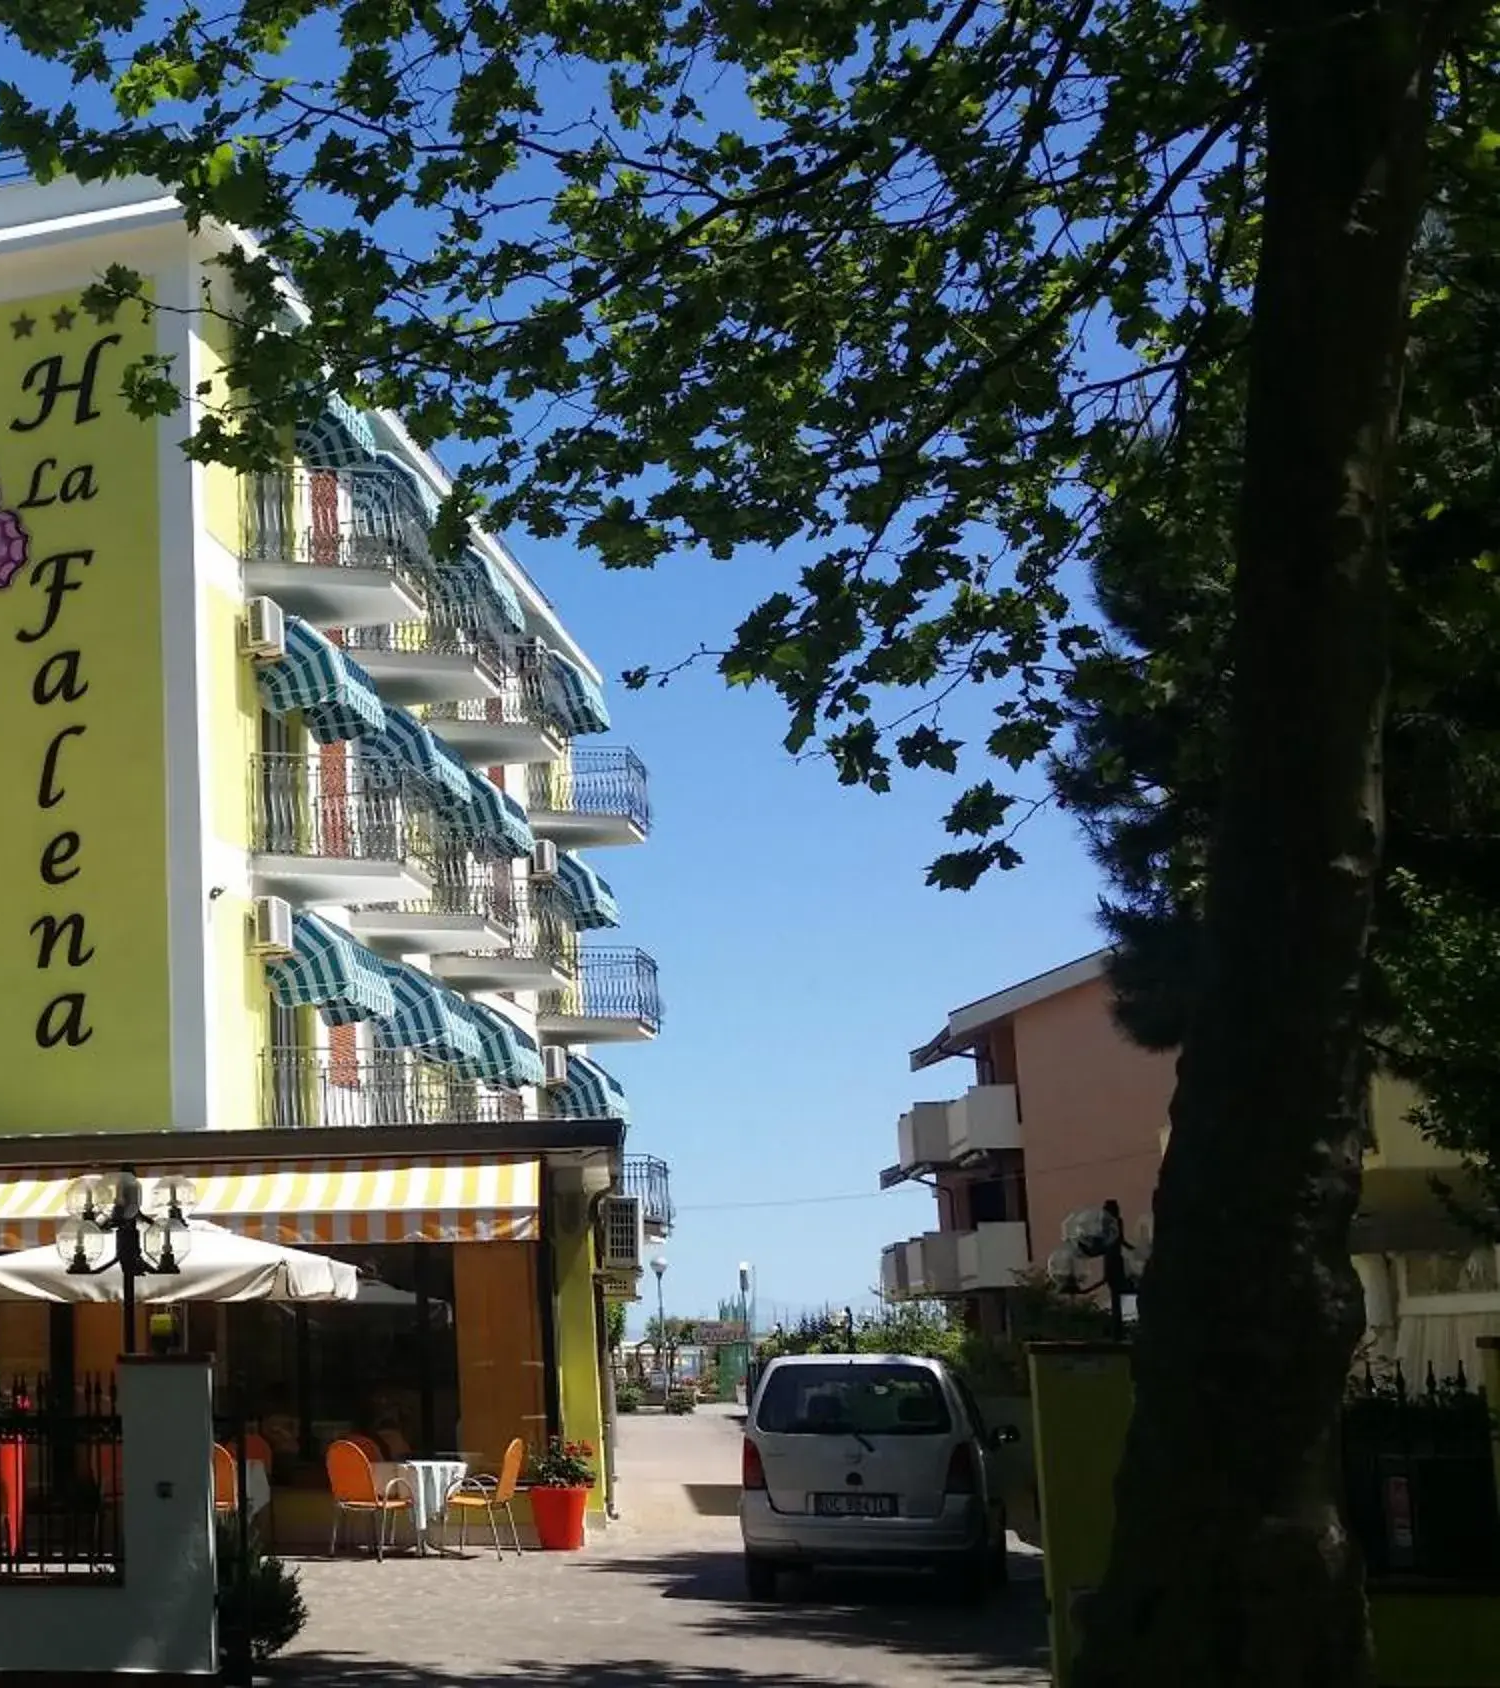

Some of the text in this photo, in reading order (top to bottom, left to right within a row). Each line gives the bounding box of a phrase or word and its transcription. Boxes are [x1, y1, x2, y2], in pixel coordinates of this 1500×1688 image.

[9, 333, 122, 1049] H La Falena
